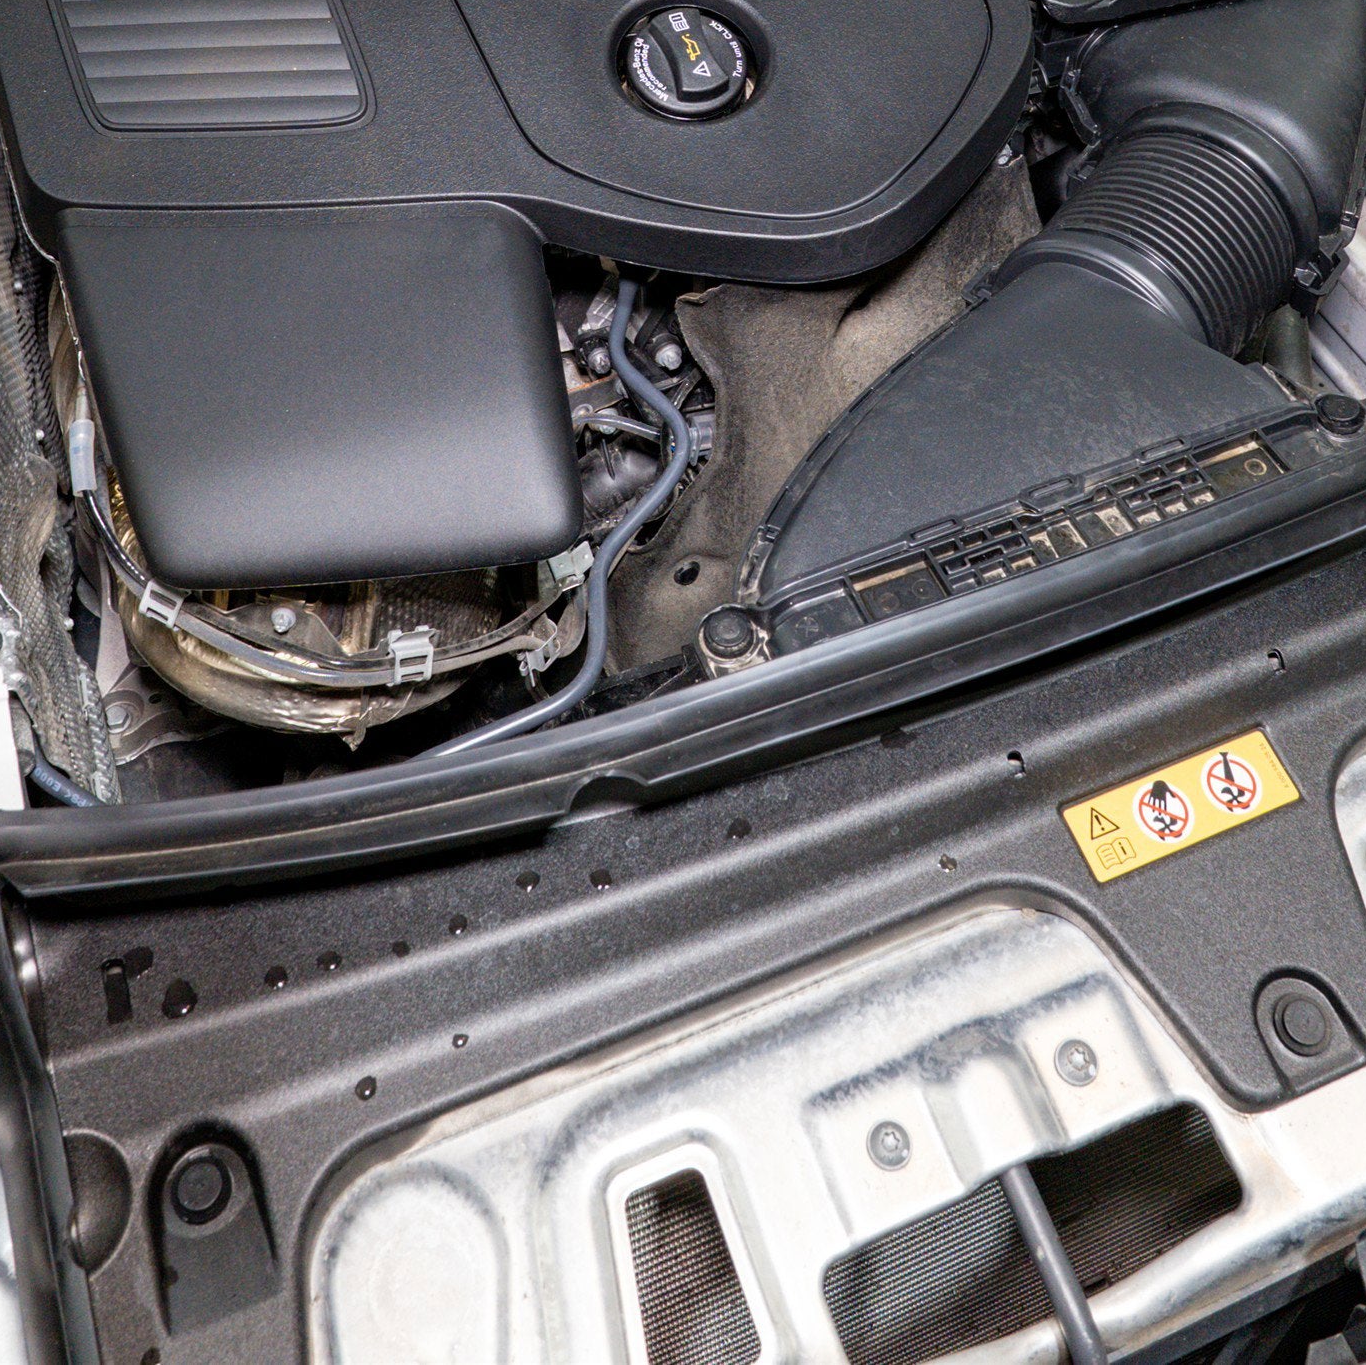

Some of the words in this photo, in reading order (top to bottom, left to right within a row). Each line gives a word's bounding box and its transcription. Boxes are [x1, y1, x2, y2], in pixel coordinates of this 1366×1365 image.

[709, 20, 733, 40] CLICK
[729, 40, 742, 58] until
[632, 48, 669, 102] Mercedes-Benz
[641, 43, 667, 91] recommended
[732, 60, 743, 78] Turn
